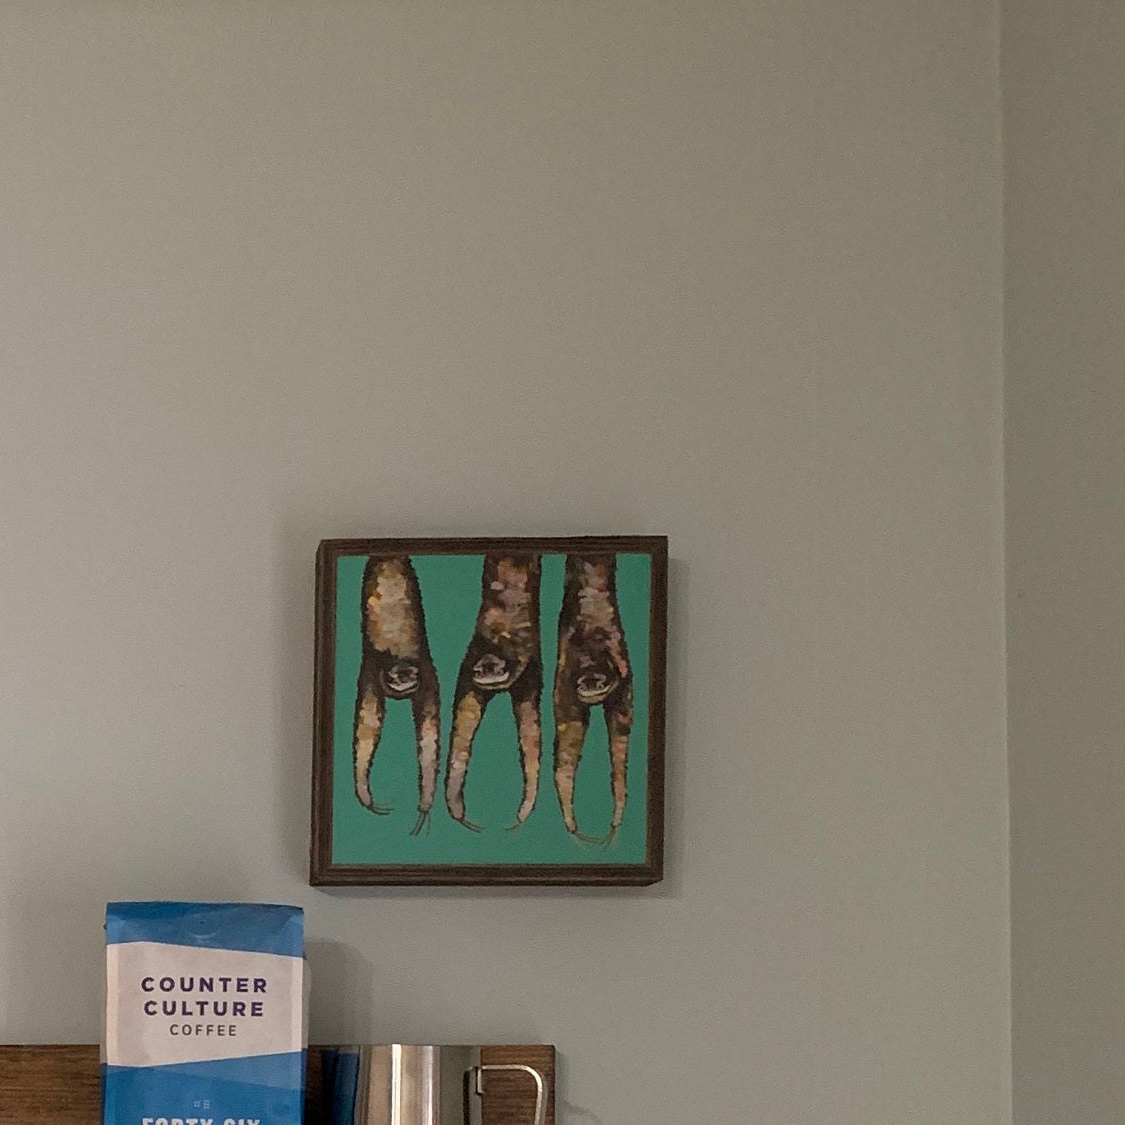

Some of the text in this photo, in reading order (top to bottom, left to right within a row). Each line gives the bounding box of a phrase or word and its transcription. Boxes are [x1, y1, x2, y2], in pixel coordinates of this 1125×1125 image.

[141, 976, 267, 993] COUNTER
[143, 1000, 263, 1017] CULTURE
[169, 1024, 237, 1036] COFFEE
